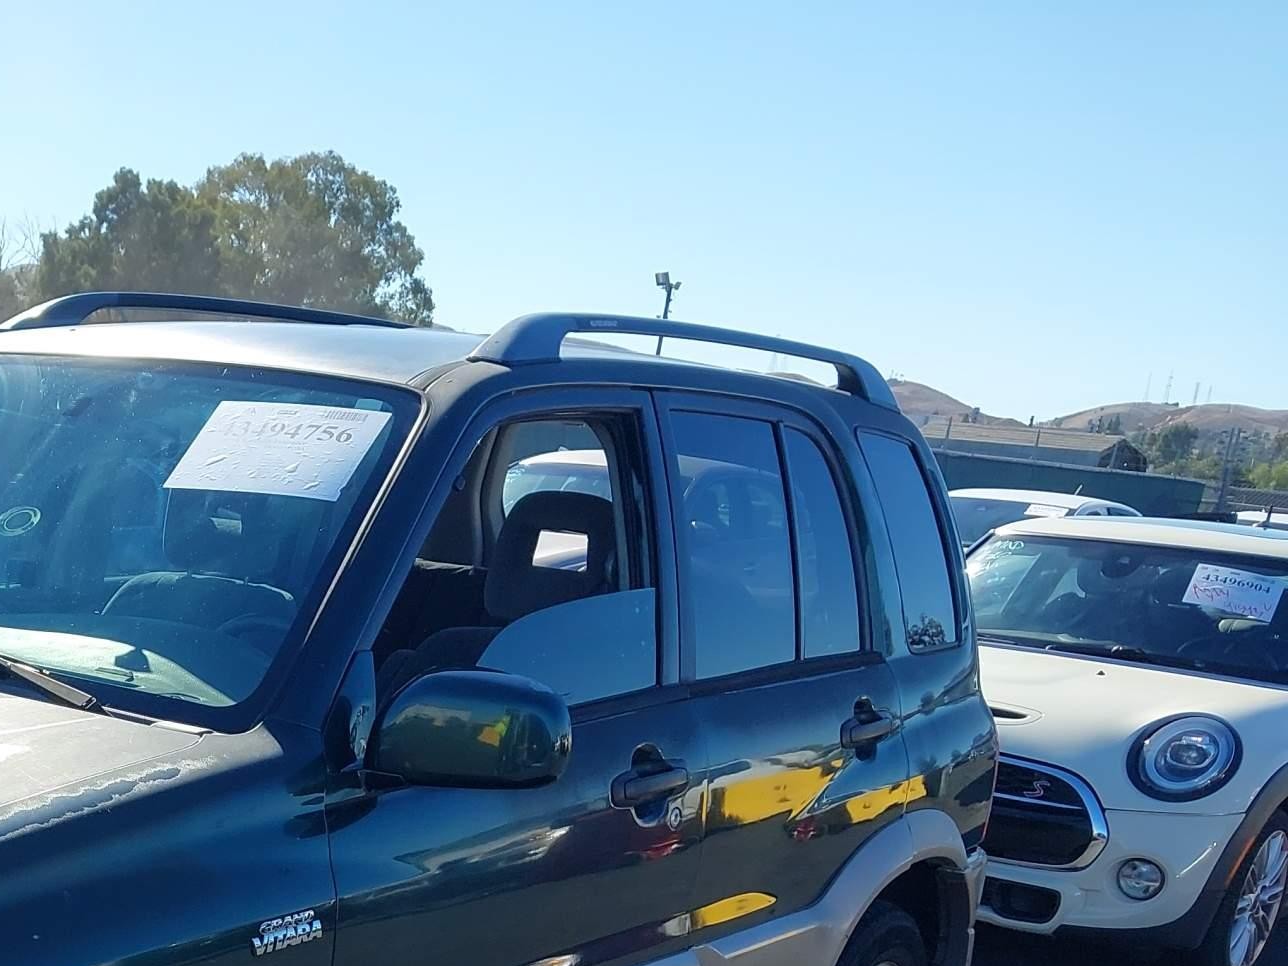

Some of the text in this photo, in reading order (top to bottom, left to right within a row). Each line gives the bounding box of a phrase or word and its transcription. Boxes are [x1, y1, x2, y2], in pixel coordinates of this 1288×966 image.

[1202, 573, 1272, 594] 43496904
[259, 909, 315, 935] GRAND
[251, 919, 323, 957] VITARA
